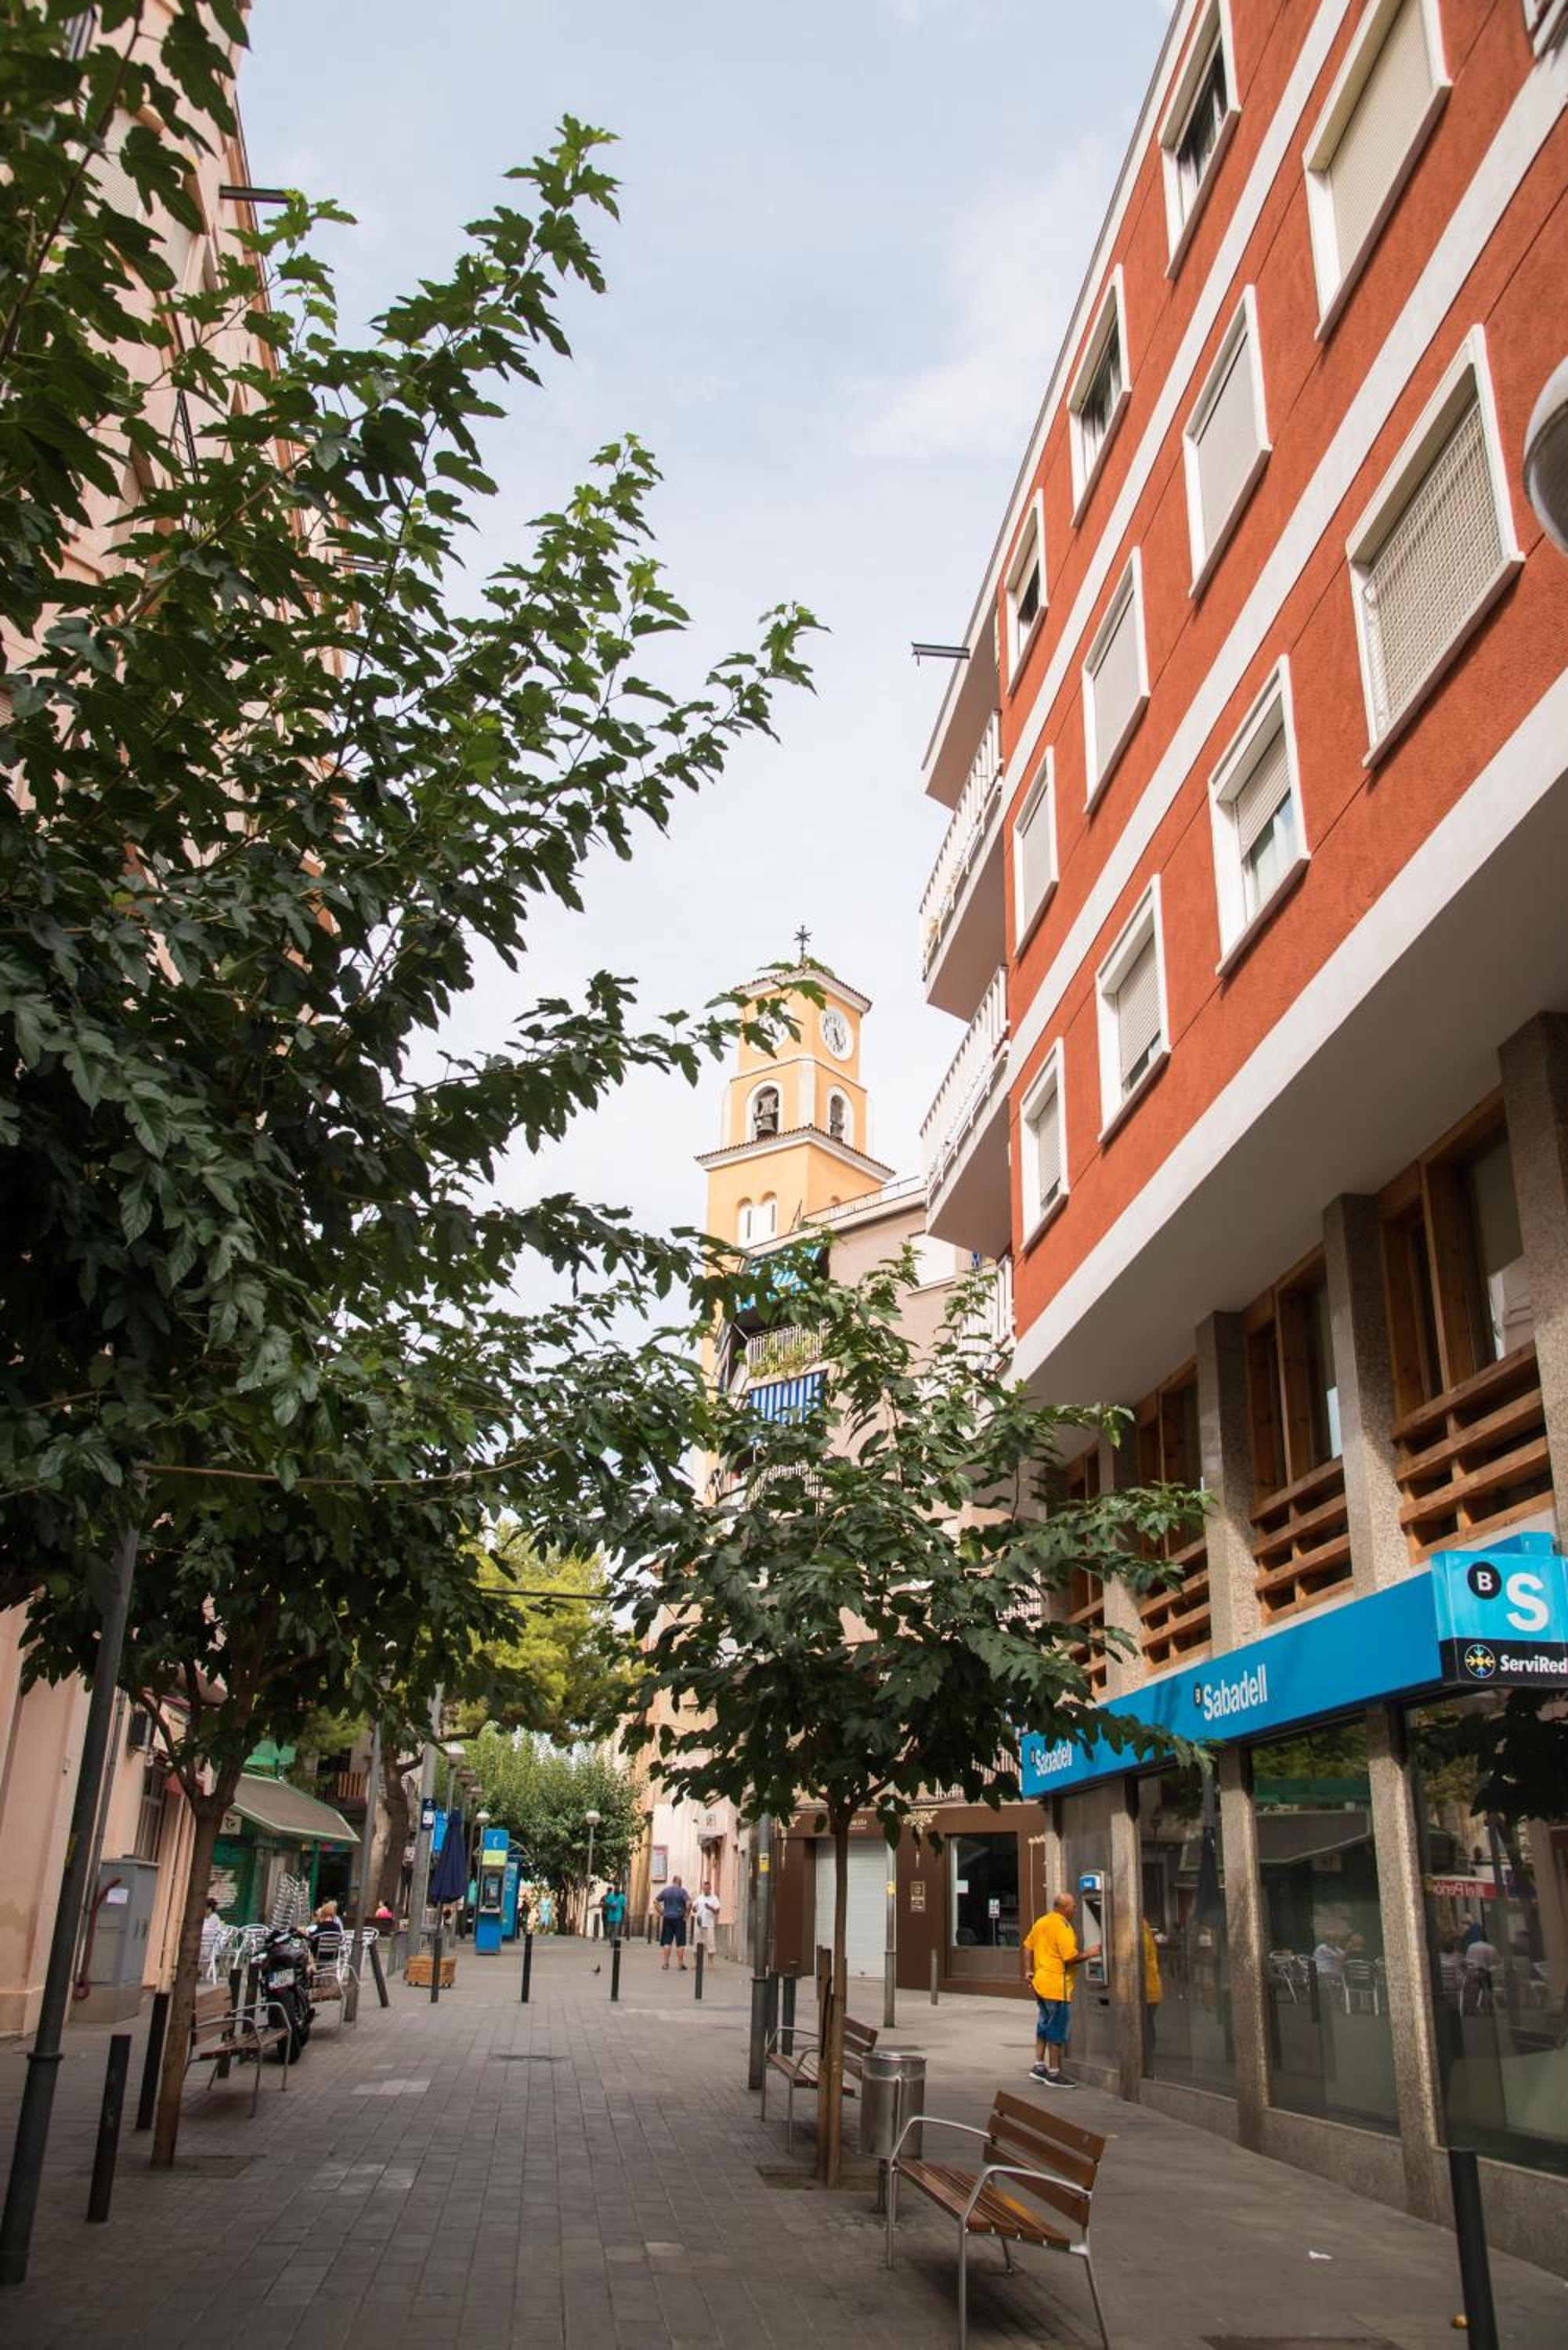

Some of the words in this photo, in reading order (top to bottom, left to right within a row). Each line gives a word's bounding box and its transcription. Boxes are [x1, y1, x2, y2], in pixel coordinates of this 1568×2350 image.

[1476, 1571, 1493, 1591] B
[1506, 1572, 1548, 1632] S
[1204, 1663, 1267, 1721] Sabadell
[1500, 1654, 1567, 1675] ServiRed
